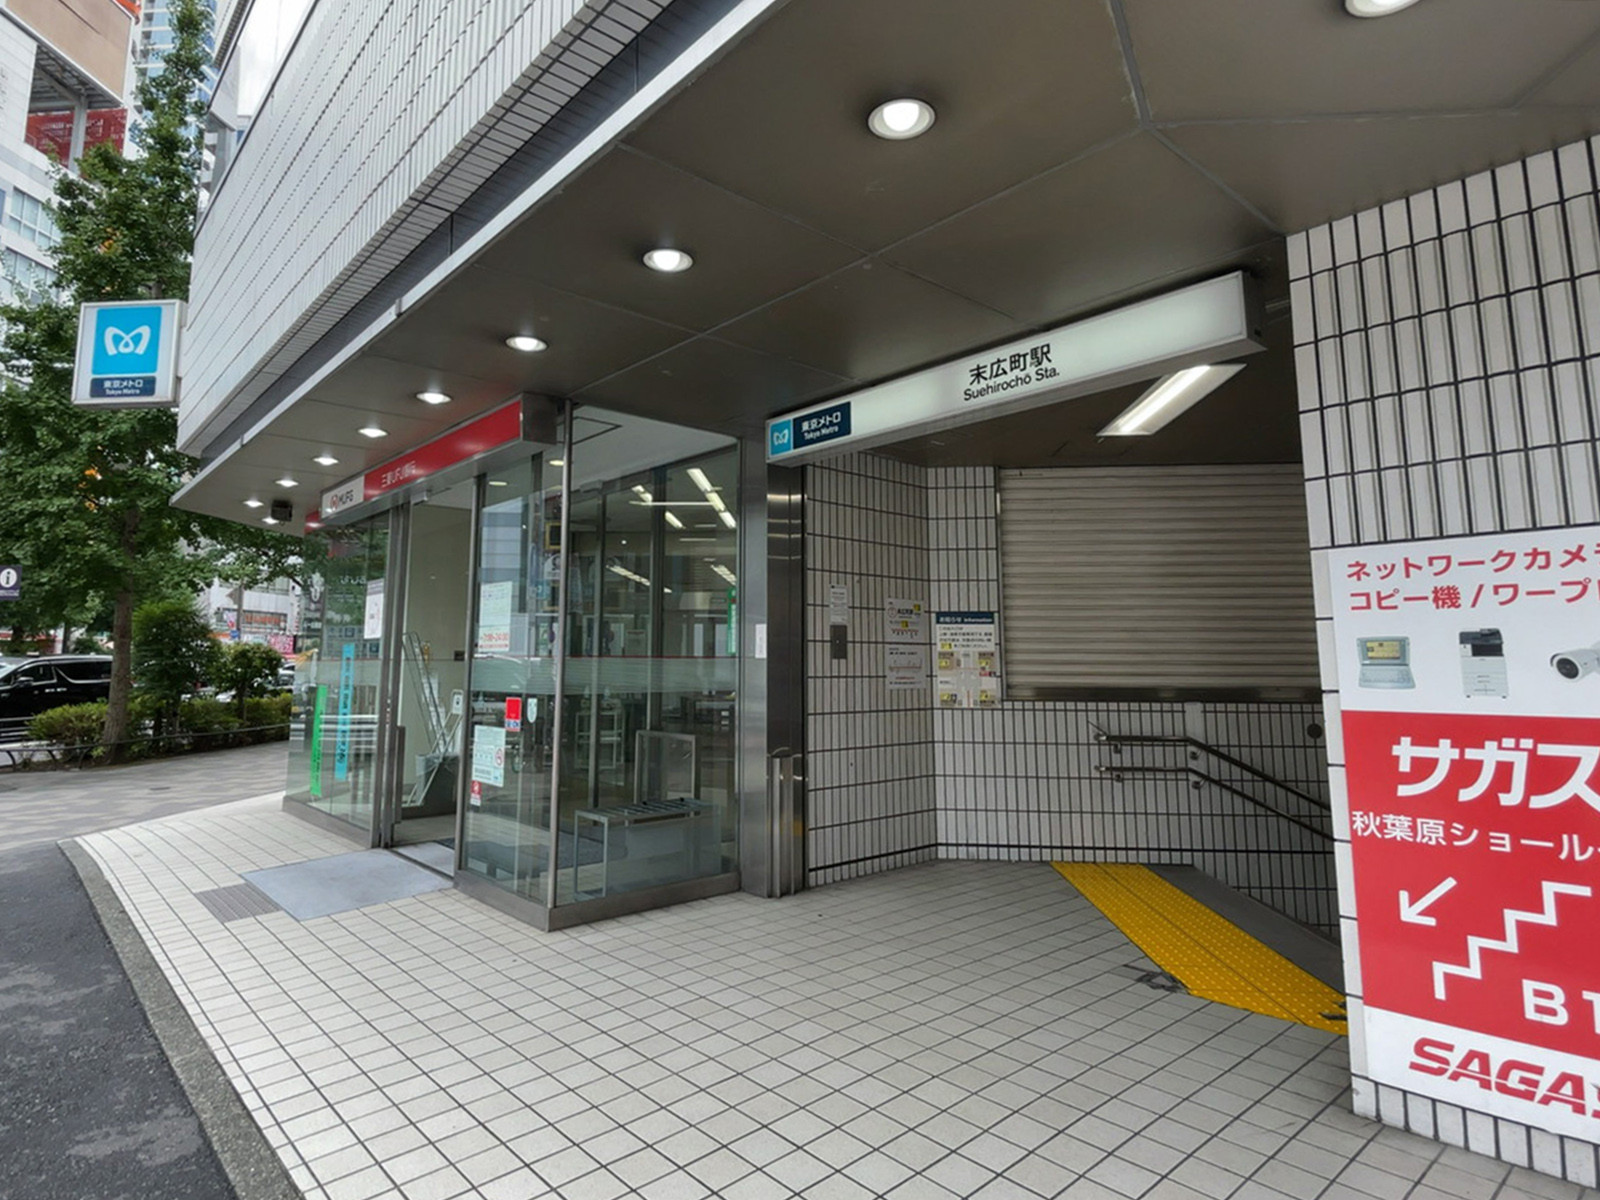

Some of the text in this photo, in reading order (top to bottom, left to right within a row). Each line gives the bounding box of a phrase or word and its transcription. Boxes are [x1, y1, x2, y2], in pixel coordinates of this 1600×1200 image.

[969, 343, 1052, 386] 末広町駅
[1035, 366, 1060, 381] Sta.
[103, 379, 143, 389] 東京メトロ
[802, 411, 841, 432] 東京メトロ
[804, 425, 839, 440] Tokyo Metro
[1350, 577, 1600, 611] コピー機/ワープ
[1352, 810, 1600, 862] 秋葉原ショール
